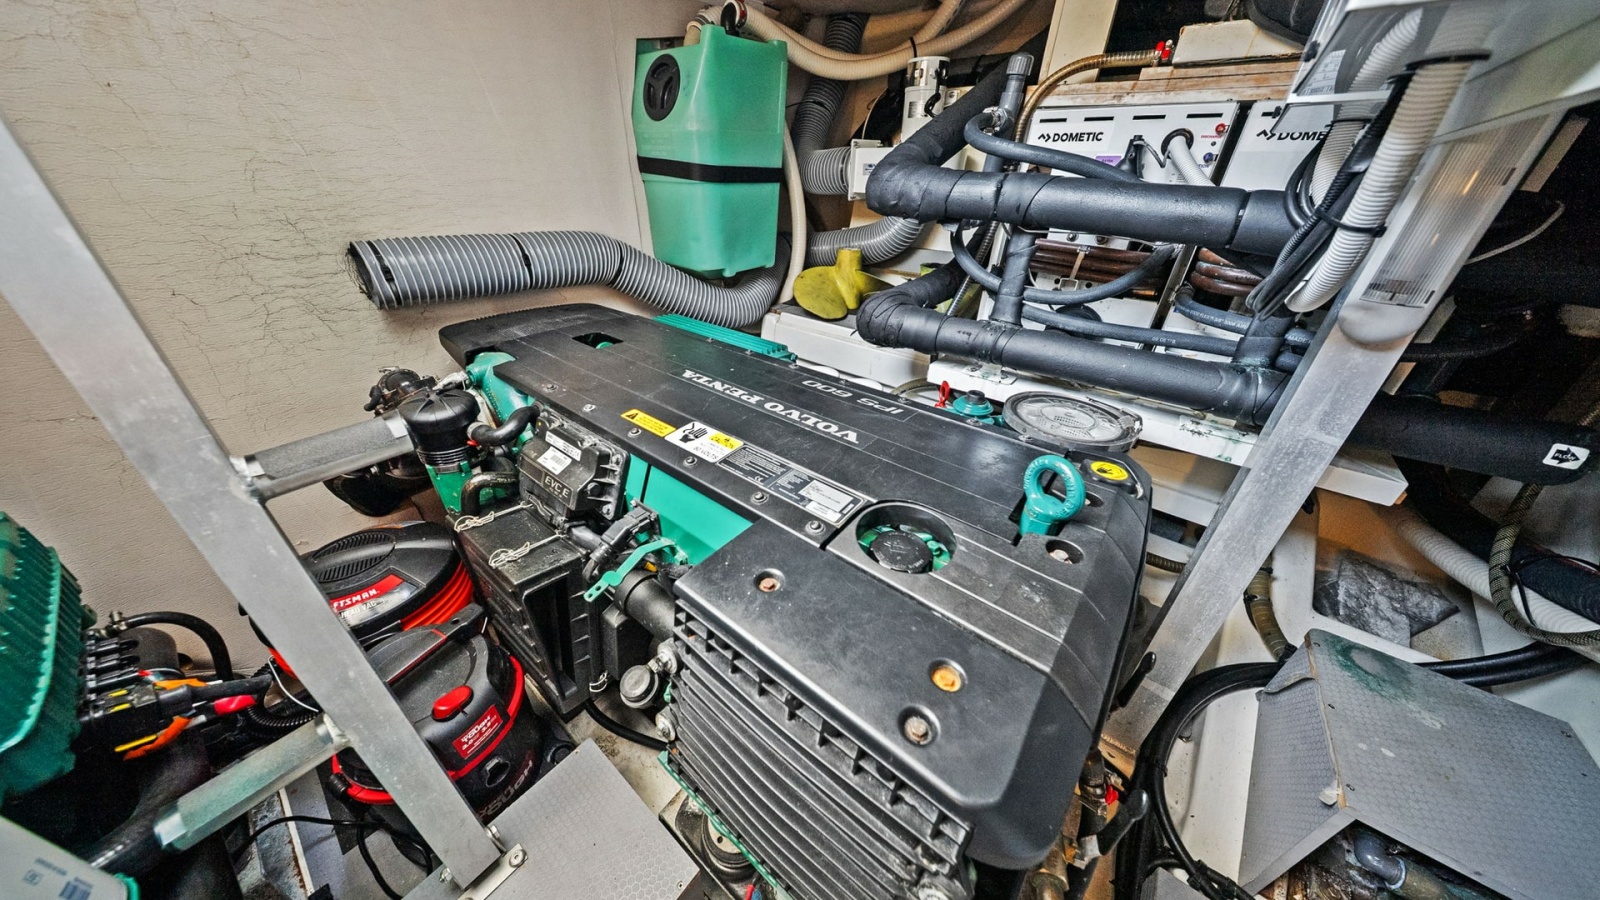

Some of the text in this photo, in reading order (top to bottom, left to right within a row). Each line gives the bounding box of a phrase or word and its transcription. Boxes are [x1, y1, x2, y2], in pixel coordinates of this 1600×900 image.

[1052, 132, 1104, 143] DOMETIC
[1277, 132, 1327, 141] DOME
[801, 380, 904, 415] IPS 600
[681, 369, 860, 444] VOLVO PENTA
[1554, 452, 1577, 461] FLOW
[544, 475, 563, 492] EVC
[562, 488, 571, 499] E
[333, 588, 377, 608] FTSMAN
[362, 600, 377, 611] VAC
